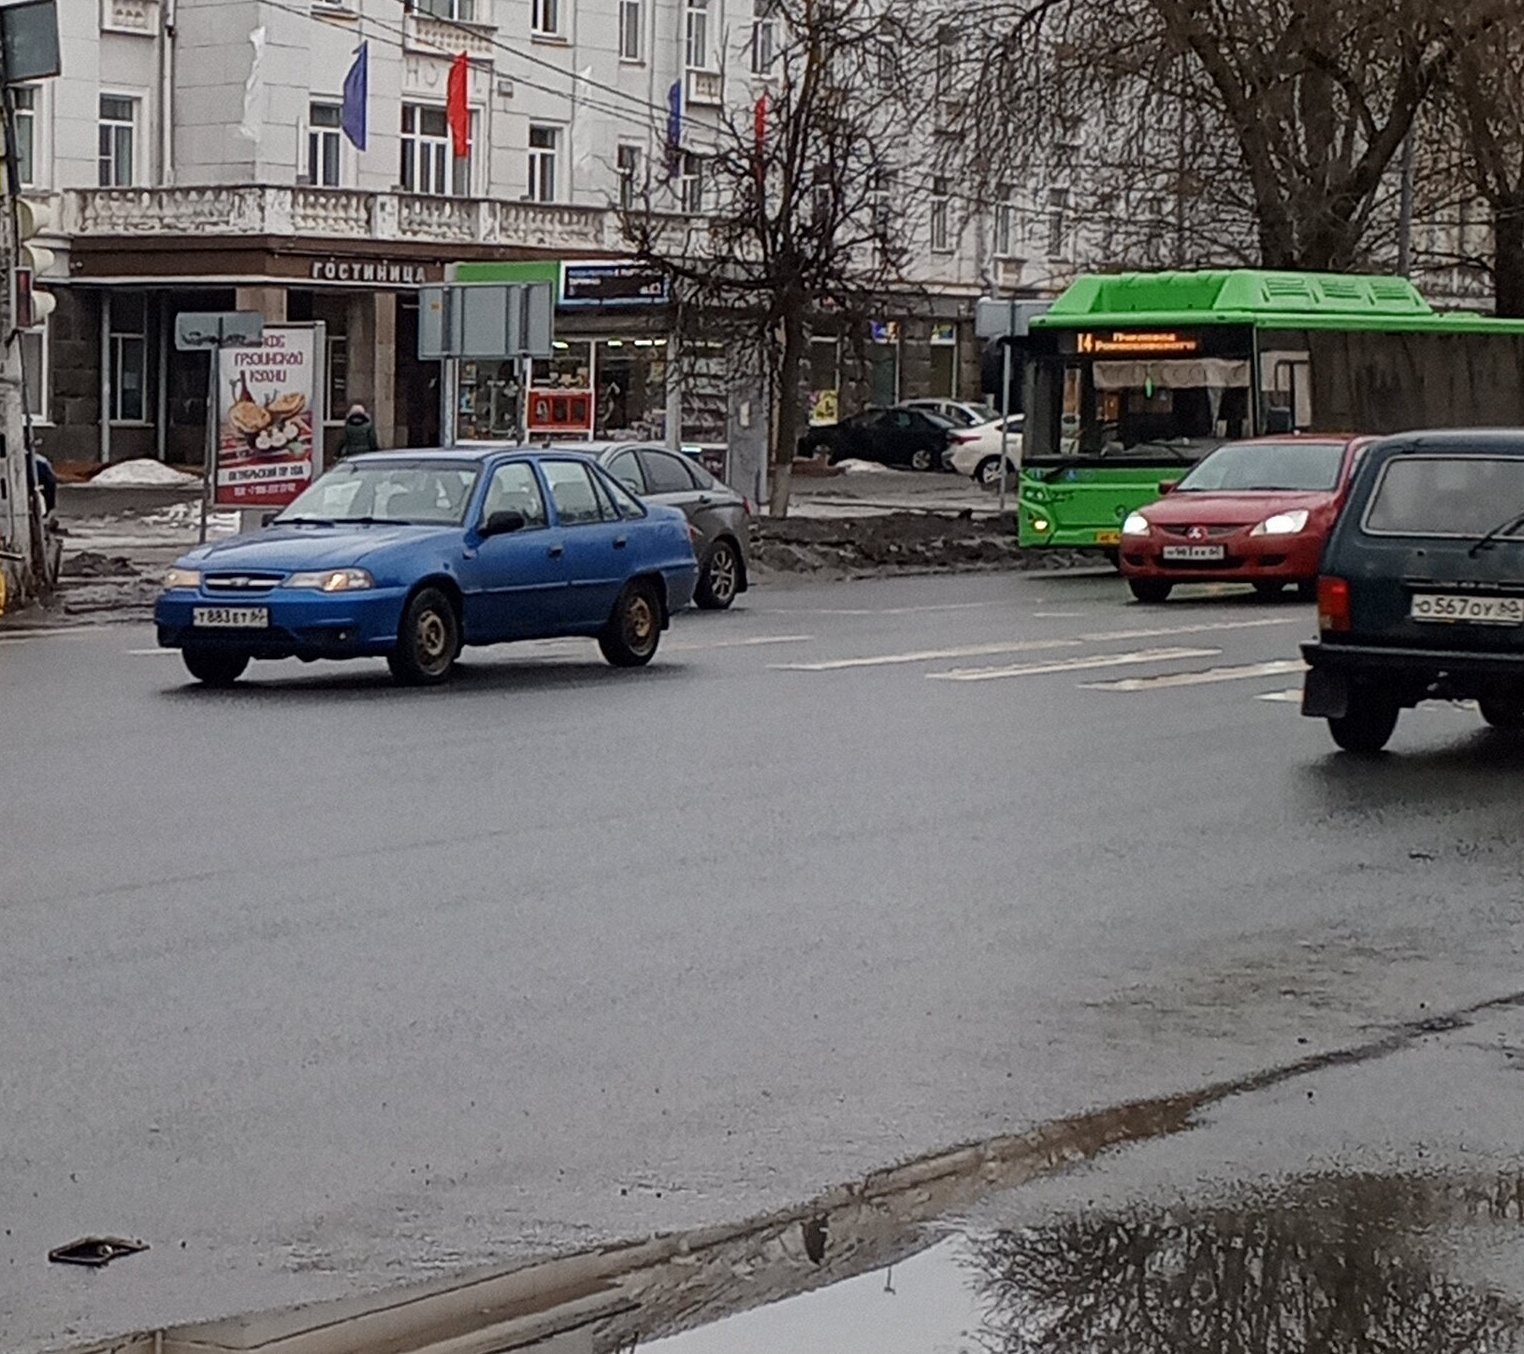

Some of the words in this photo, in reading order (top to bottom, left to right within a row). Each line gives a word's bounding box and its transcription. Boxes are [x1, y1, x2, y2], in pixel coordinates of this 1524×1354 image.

[312, 261, 426, 284] ГОСТИНИЦА
[1077, 333, 1093, 353] 14
[234, 351, 303, 366] ГРУЗИНСКОЙ
[249, 369, 287, 383] КУХНИ
